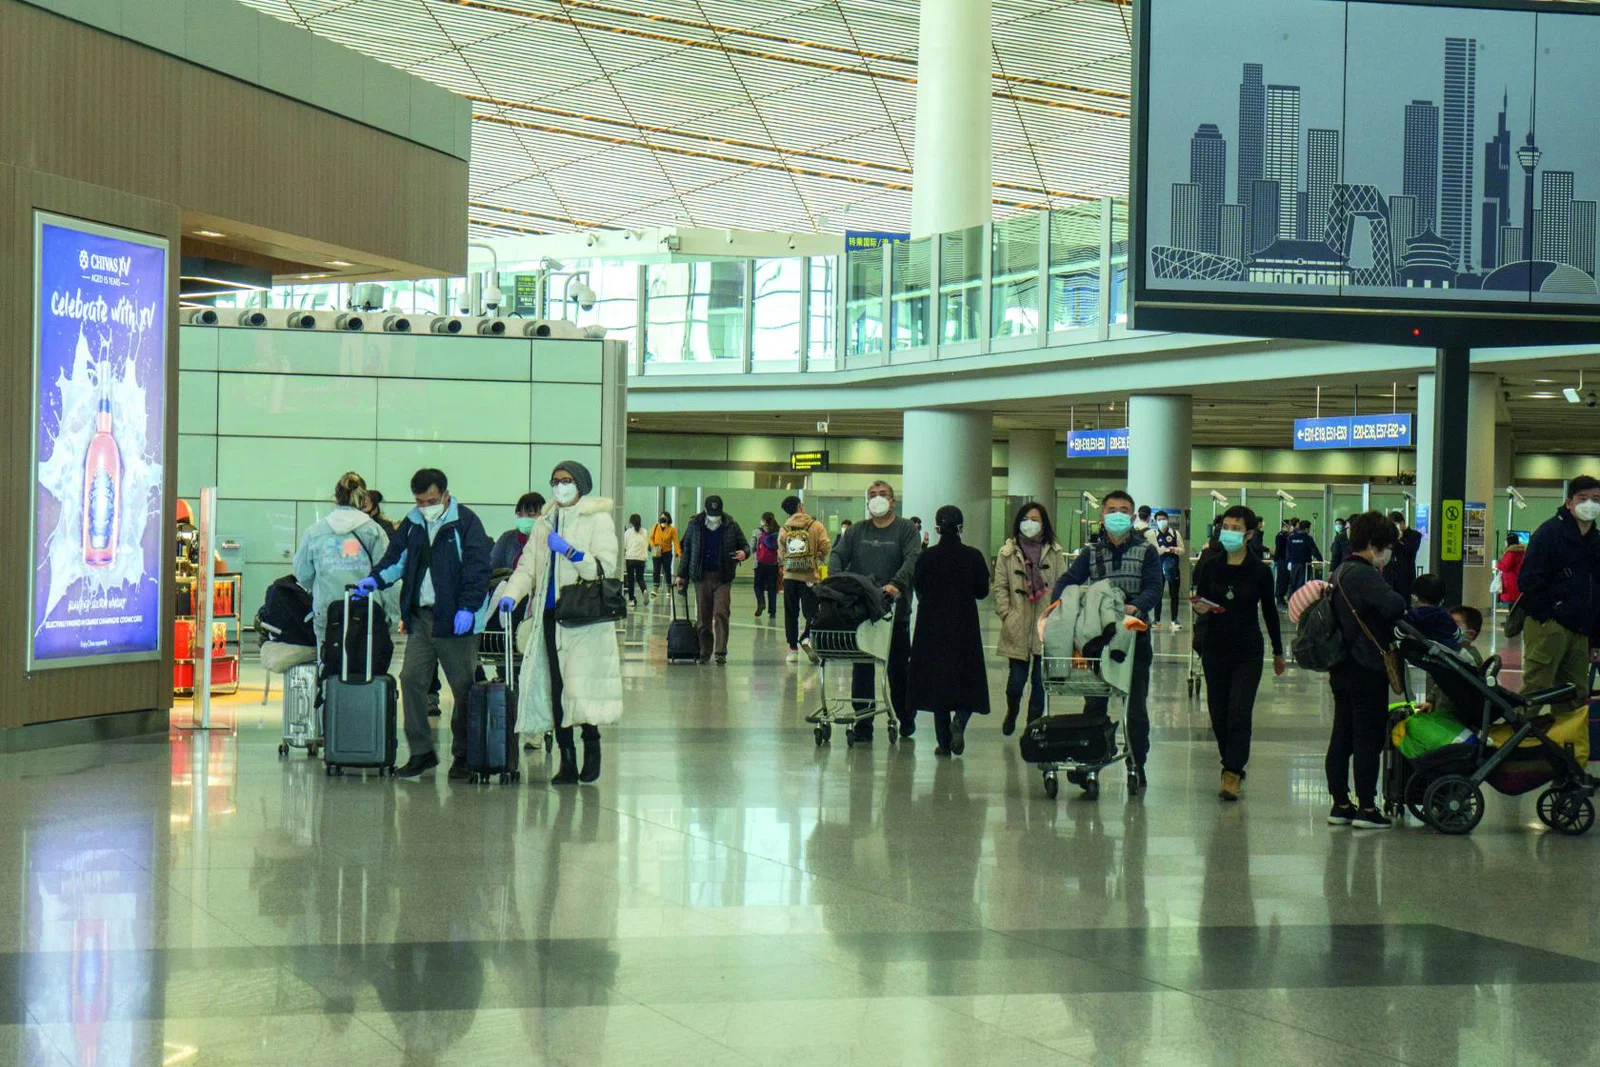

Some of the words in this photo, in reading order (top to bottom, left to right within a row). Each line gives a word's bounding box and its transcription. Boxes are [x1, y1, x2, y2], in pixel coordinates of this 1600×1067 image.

[91, 254, 119, 273] CHIVAS
[91, 274, 104, 284] AGED
[104, 276, 109, 285] 15
[109, 277, 121, 287] YEARS
[51, 288, 108, 323] Celebrate
[111, 295, 136, 333] with
